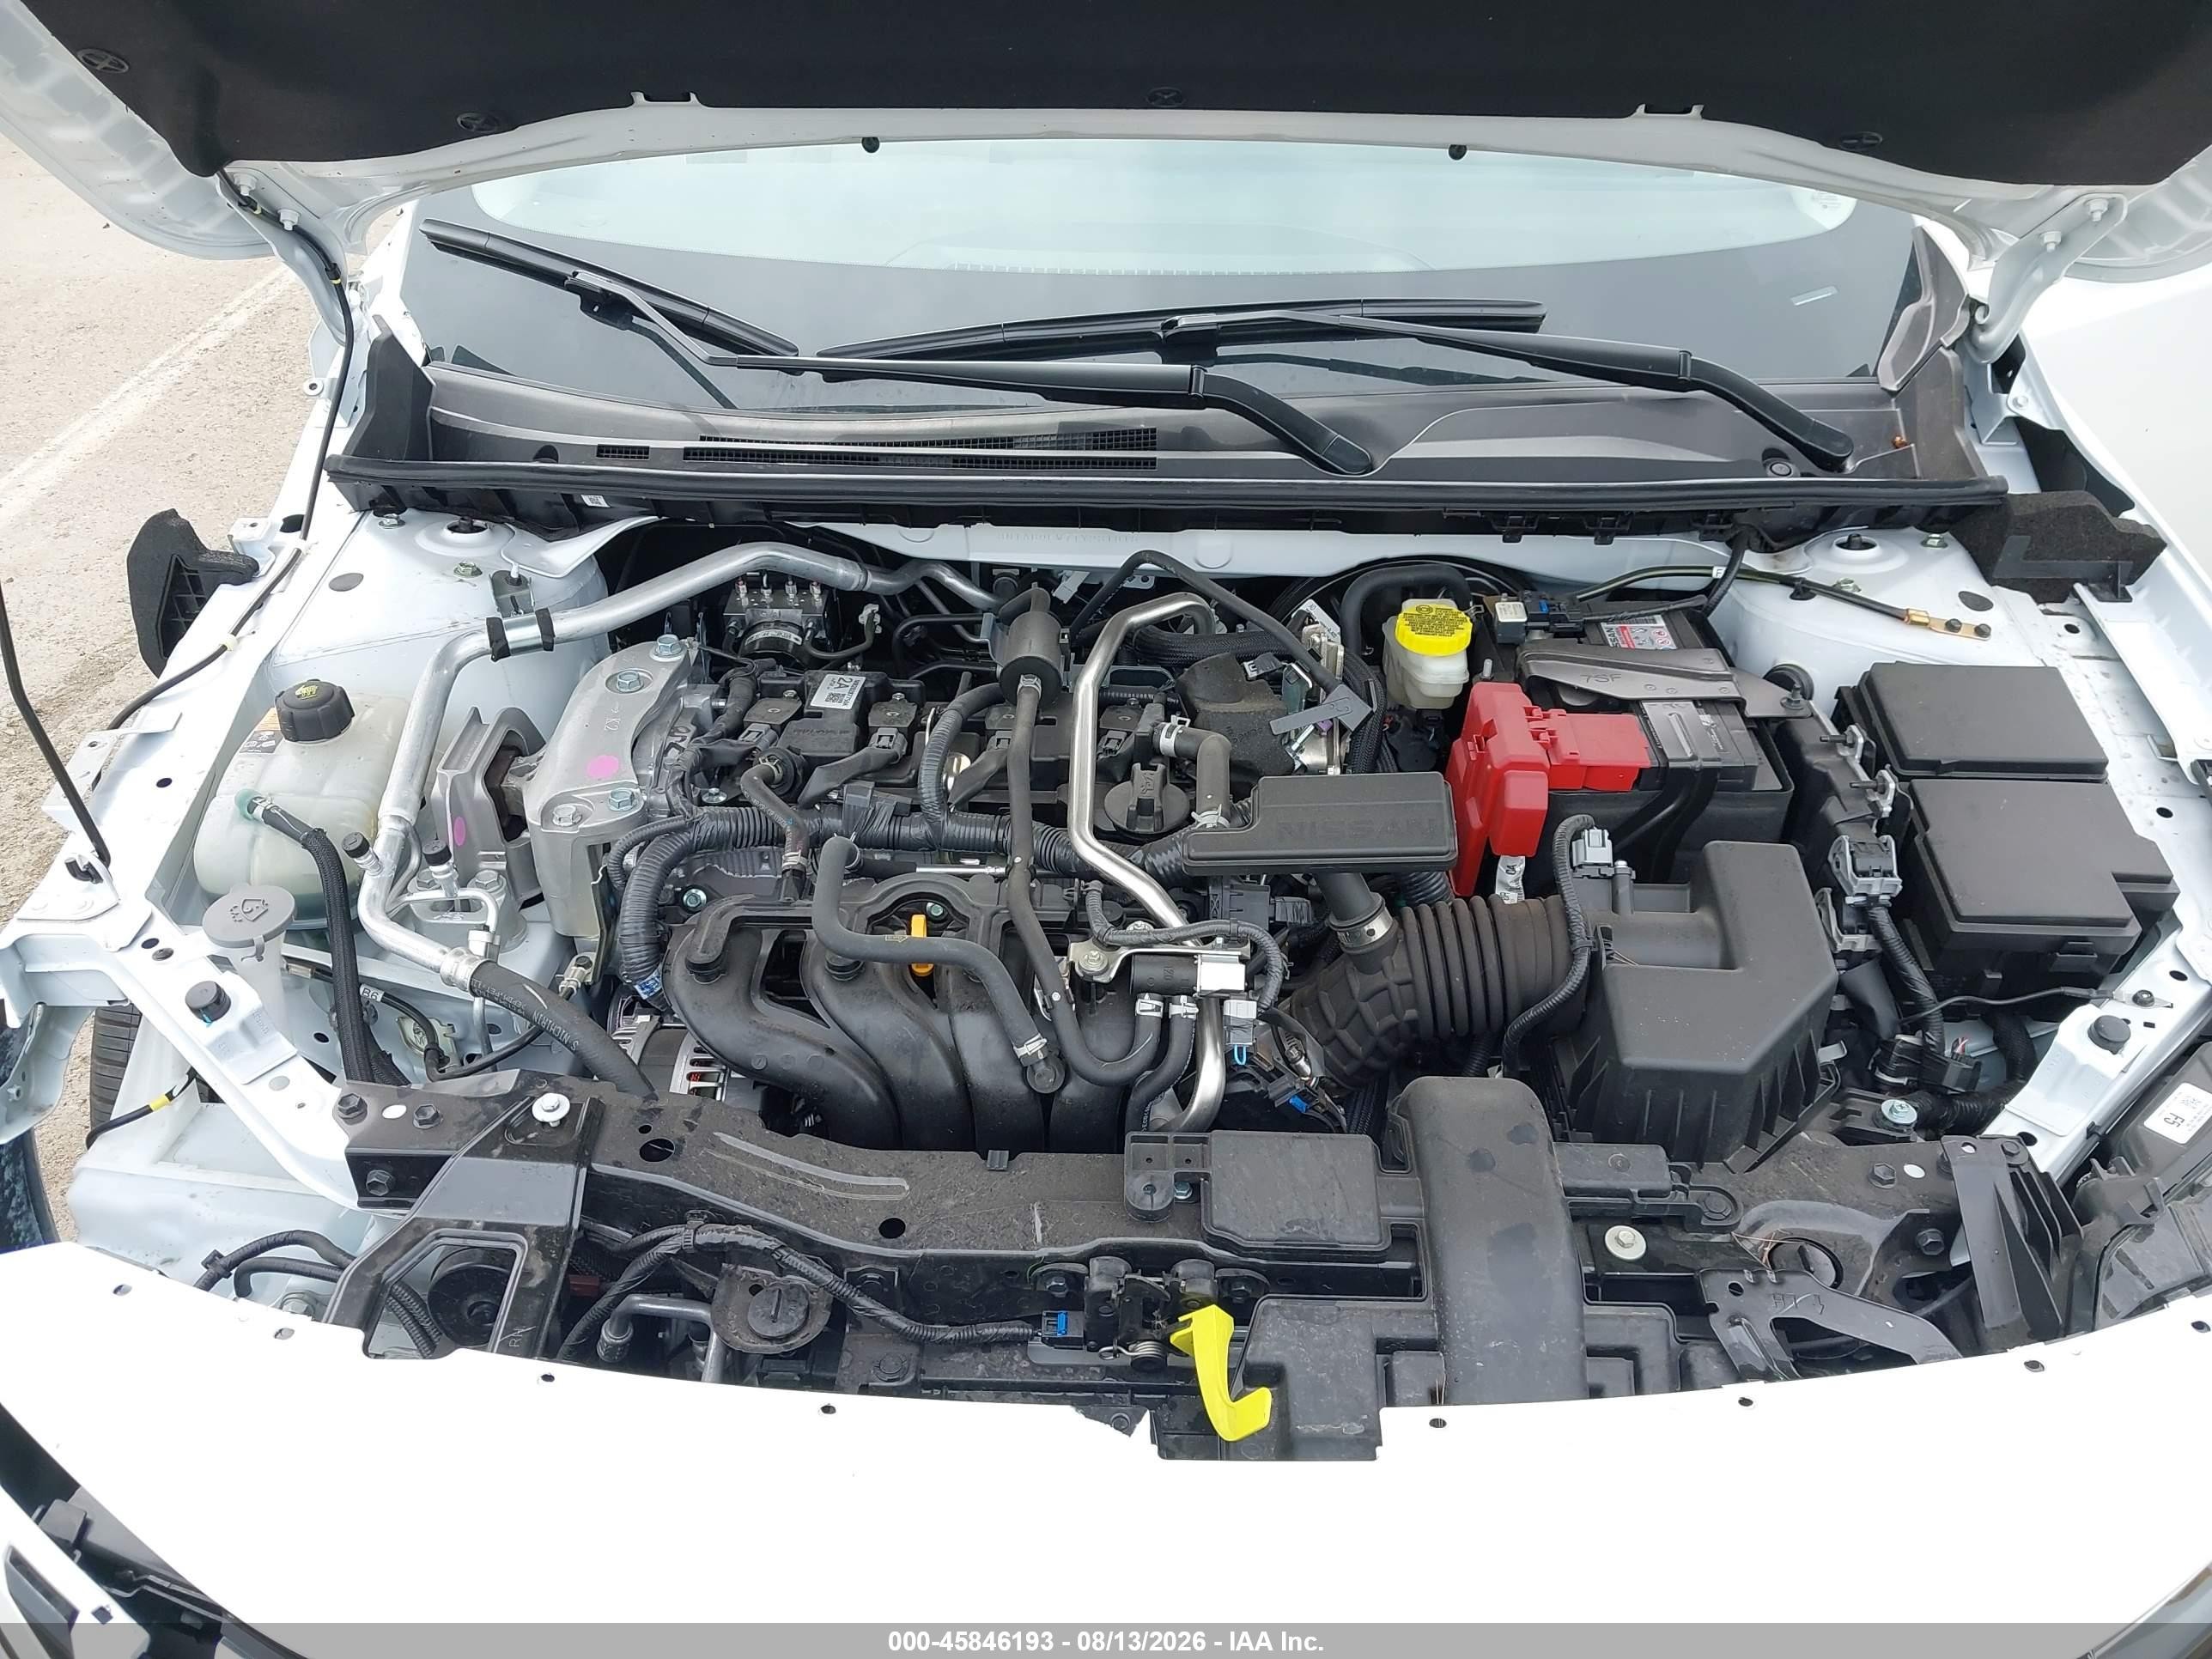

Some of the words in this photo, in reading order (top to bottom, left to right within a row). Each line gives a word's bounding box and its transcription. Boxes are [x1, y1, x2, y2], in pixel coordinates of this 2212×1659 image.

[833, 677, 853, 690] 2A
[362, 988, 380, 1000] B6
[2163, 1112, 2185, 1127] F5
